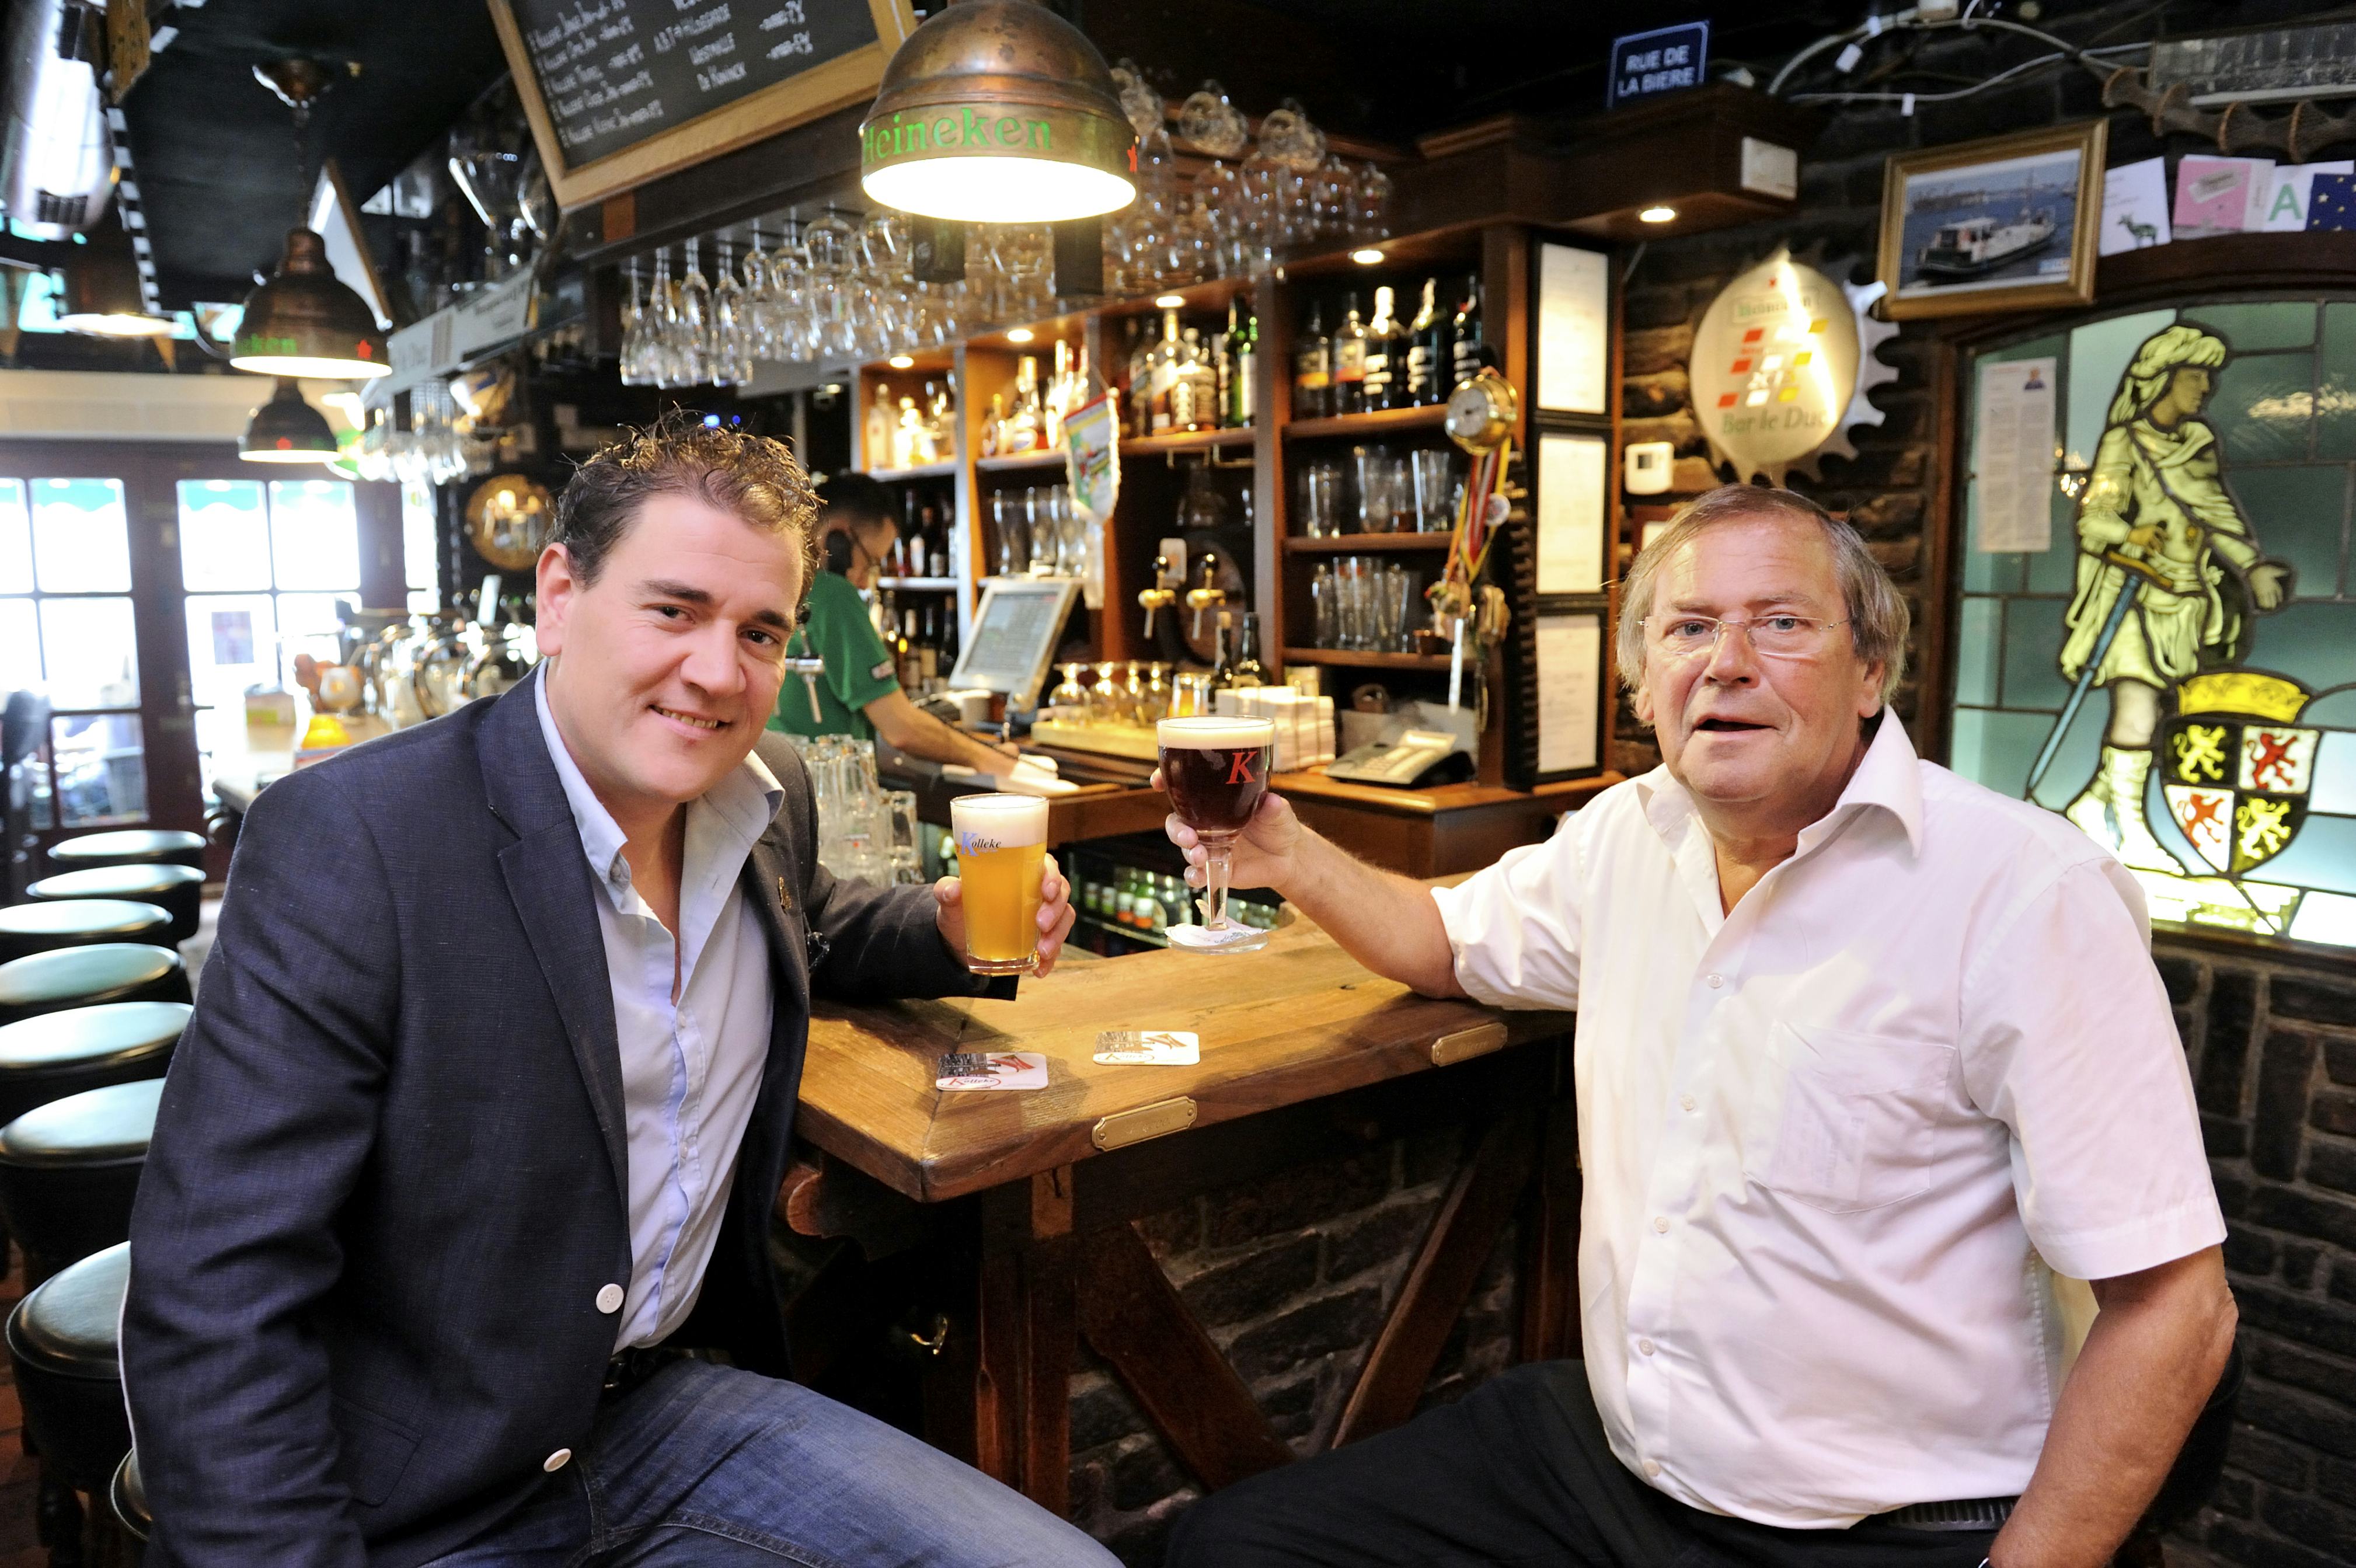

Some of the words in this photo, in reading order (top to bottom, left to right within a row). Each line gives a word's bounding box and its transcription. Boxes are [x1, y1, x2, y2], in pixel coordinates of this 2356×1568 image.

[1625, 50, 1661, 73] RUE
[1664, 44, 1690, 67] DE
[1617, 76, 1639, 97] LA
[862, 107, 1051, 165] Heineken
[1225, 751, 1258, 785] K
[961, 831, 1002, 856] Kolleke
